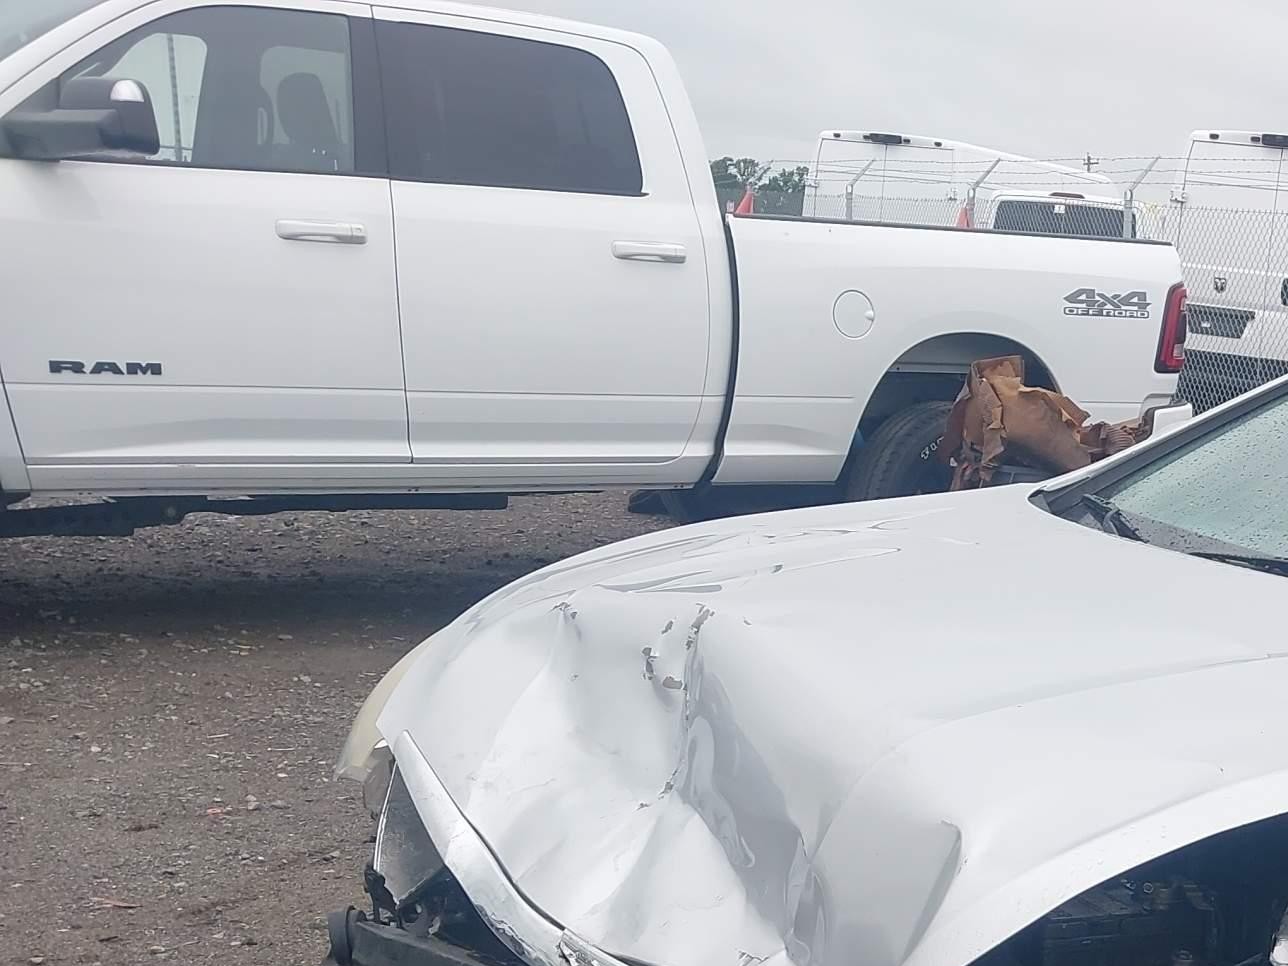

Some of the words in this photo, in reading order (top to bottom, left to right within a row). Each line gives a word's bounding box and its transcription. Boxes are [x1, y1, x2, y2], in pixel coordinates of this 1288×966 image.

[1064, 307, 1101, 316] OFF
[1102, 309, 1149, 319] ROAD
[48, 359, 162, 376] RAM
